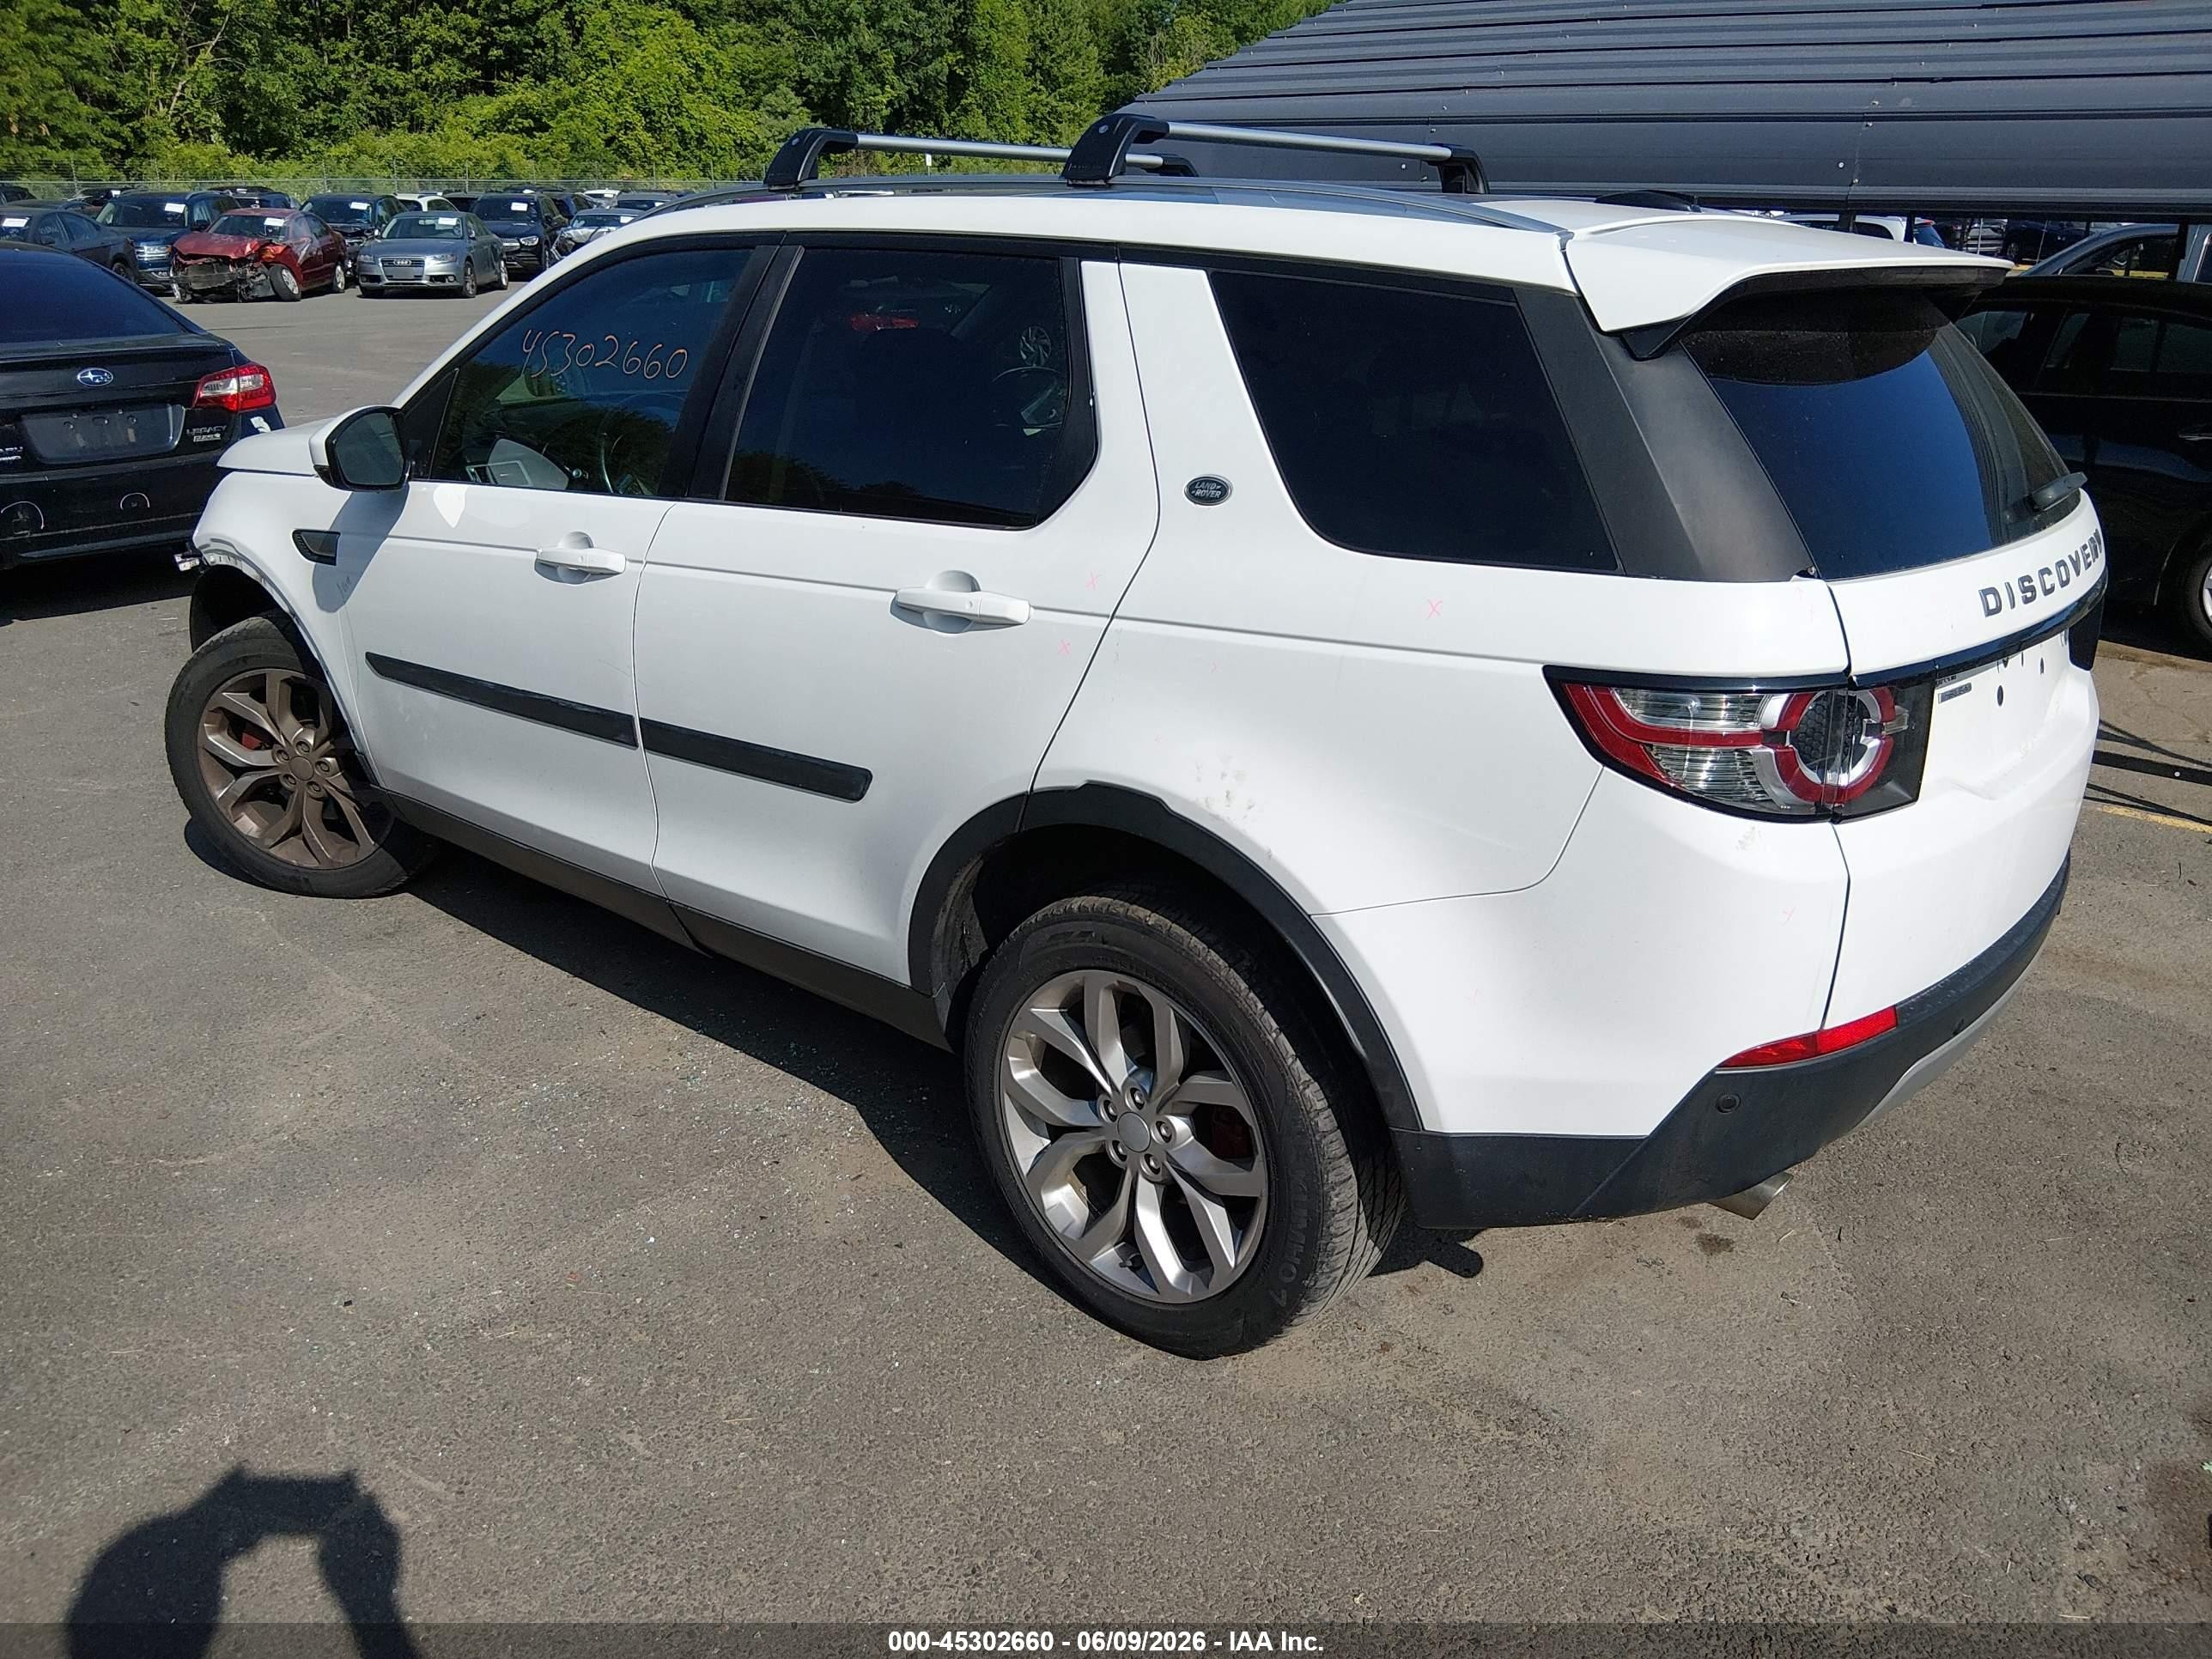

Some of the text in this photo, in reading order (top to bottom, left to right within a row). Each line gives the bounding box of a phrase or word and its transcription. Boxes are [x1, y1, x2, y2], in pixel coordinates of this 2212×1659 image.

[521, 329, 688, 379] 45302660
[186, 425, 227, 435] LEGACY
[1194, 482, 1217, 490] LAND
[1194, 489, 1221, 498] ROVER
[1278, 1169, 1308, 1284] KUMHO
